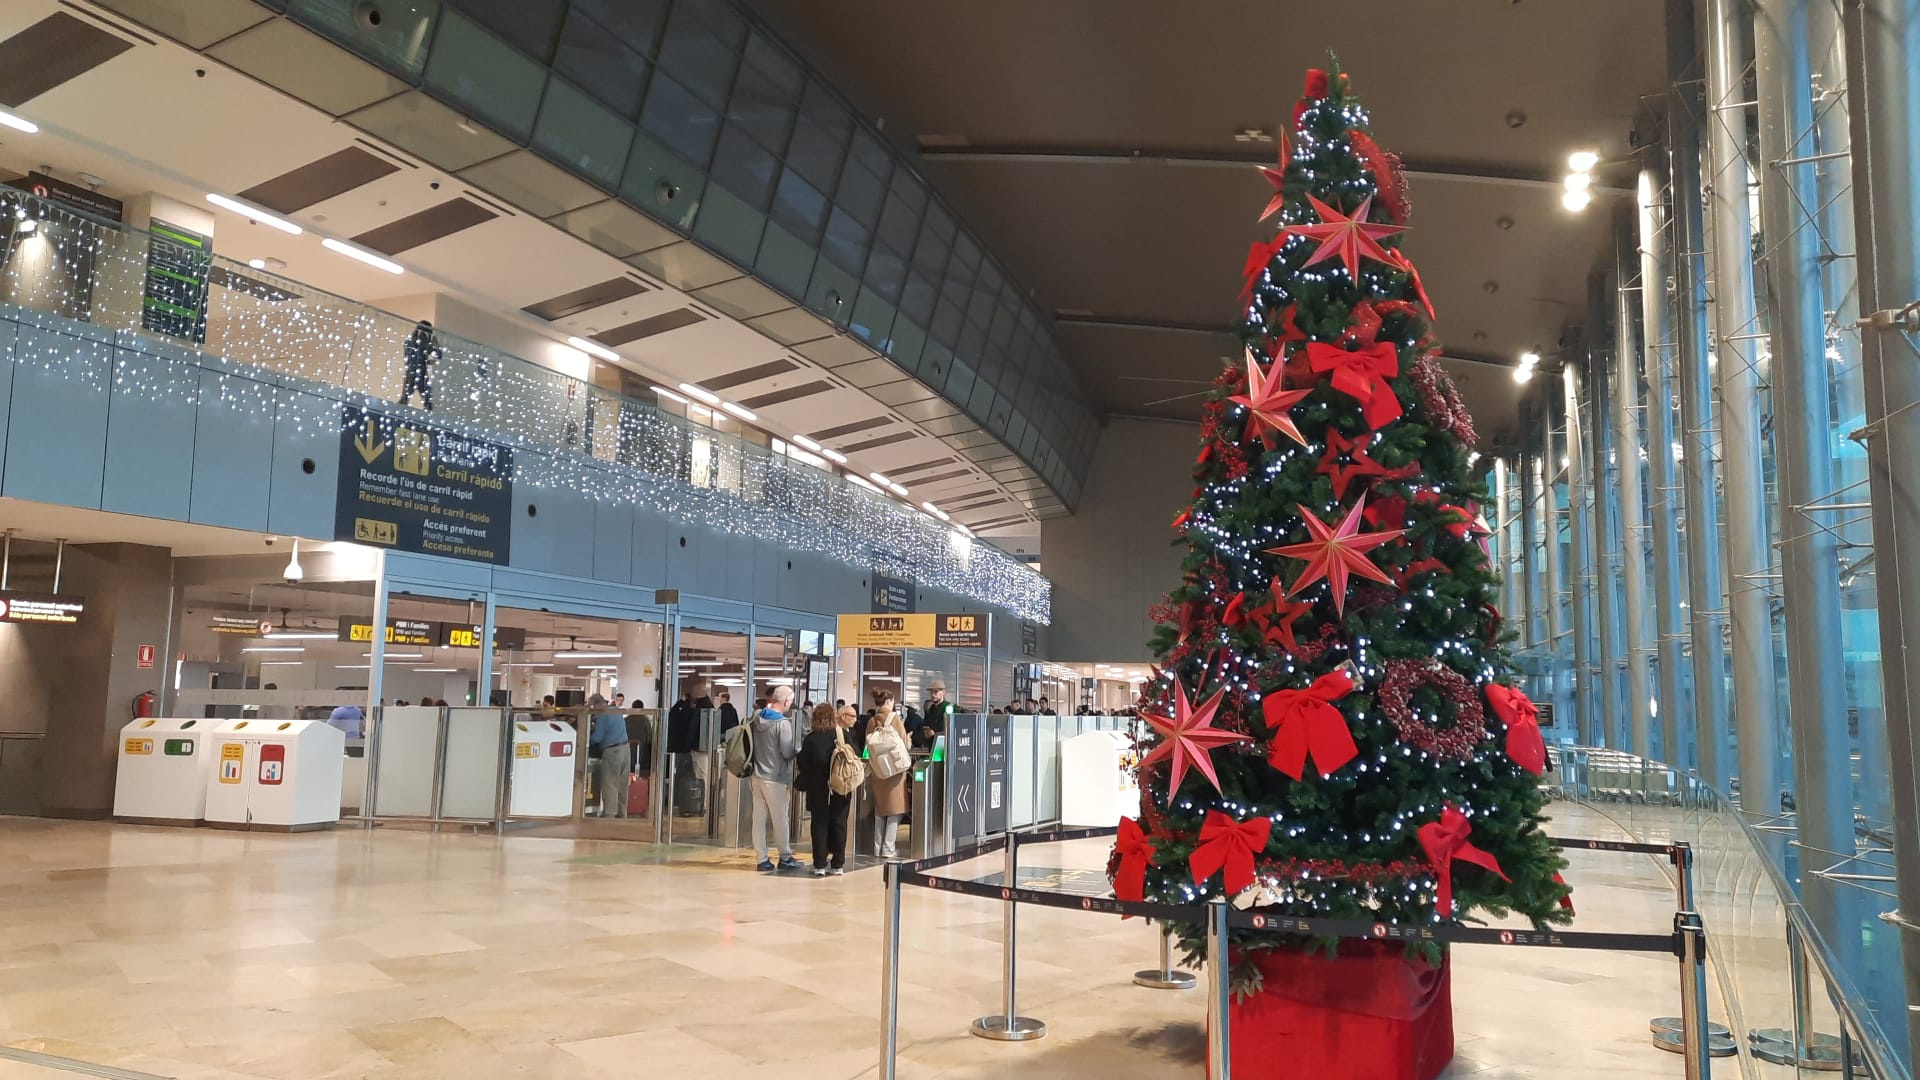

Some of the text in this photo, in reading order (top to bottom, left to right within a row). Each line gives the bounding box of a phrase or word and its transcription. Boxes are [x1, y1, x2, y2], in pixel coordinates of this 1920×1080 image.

[360, 468, 398, 485] Recorde
[416, 479, 427, 491] de
[429, 482, 451, 495] carril
[436, 464, 502, 490] Carril rápido
[359, 481, 397, 496] Remember
[399, 487, 411, 498] fast
[412, 490, 426, 501] lane
[359, 490, 402, 507] Recuerde
[404, 499, 412, 509] el
[414, 502, 428, 512] uso
[430, 504, 441, 514] de
[442, 506, 464, 519] carril
[423, 519, 486, 538] Accés preferent
[423, 530, 444, 542] Priority
[422, 539, 494, 559] Acceso preferente
